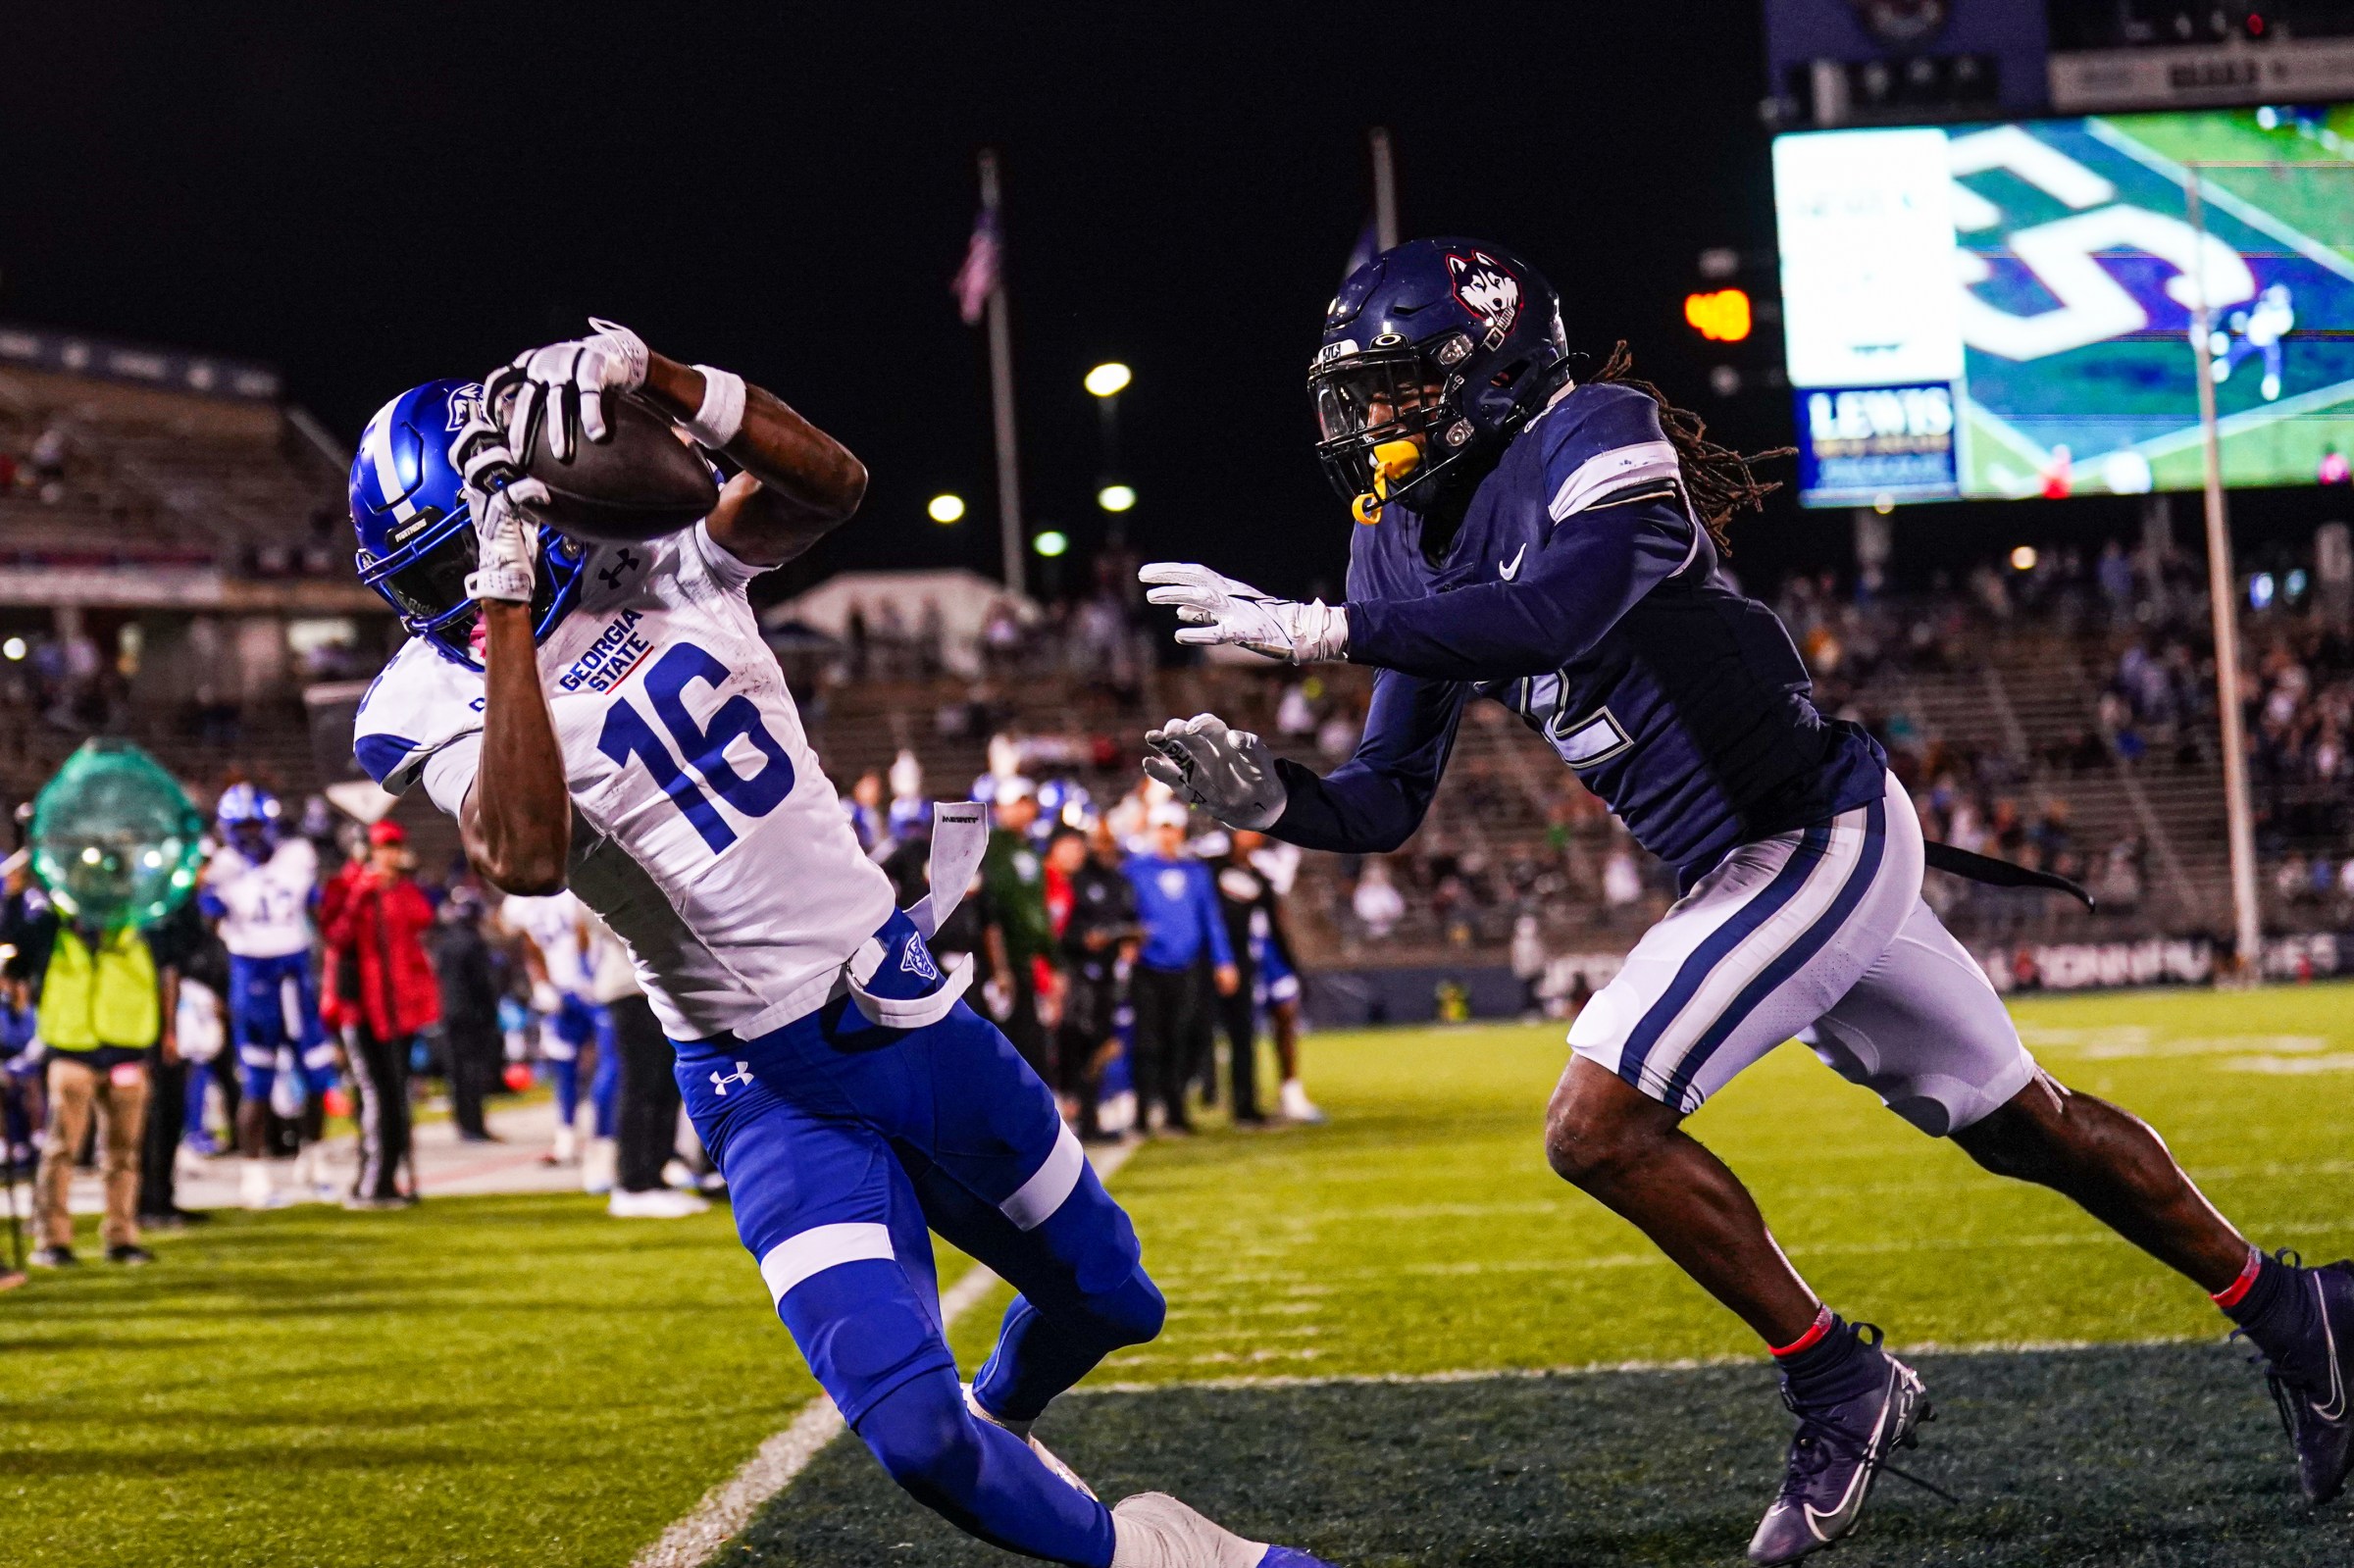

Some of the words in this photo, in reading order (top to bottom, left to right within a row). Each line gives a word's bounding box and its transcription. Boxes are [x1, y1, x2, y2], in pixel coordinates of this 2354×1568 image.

[559, 607, 643, 691] GEORGIA
[588, 631, 649, 692] STATE
[596, 641, 795, 856] 16
